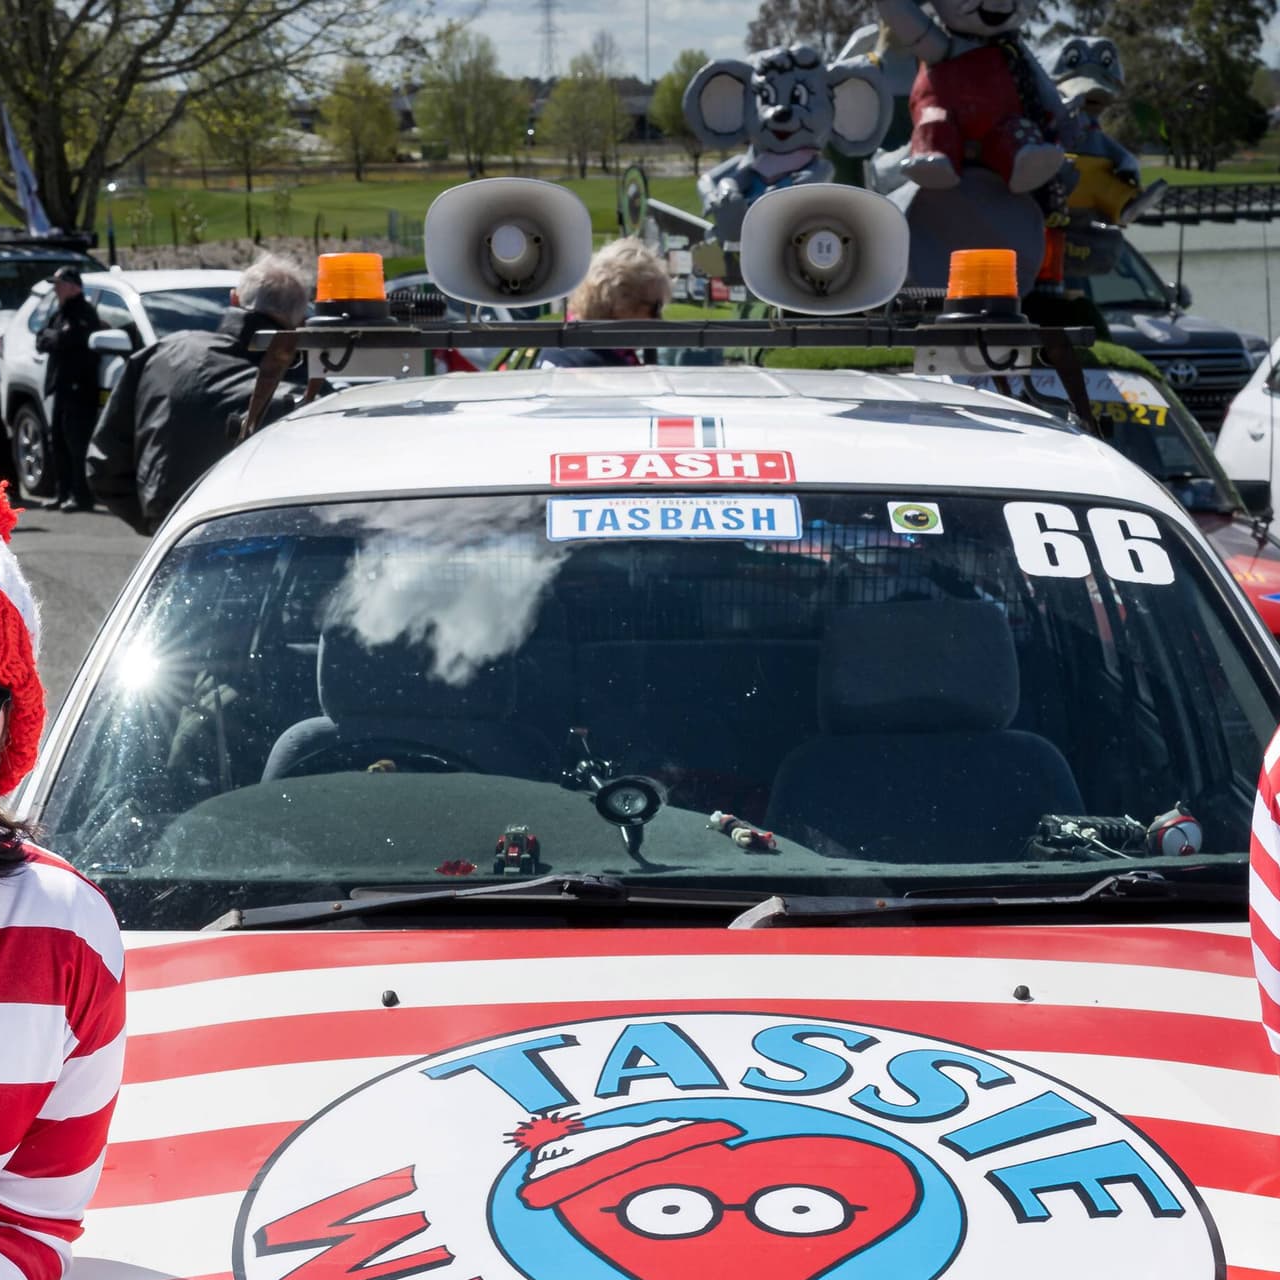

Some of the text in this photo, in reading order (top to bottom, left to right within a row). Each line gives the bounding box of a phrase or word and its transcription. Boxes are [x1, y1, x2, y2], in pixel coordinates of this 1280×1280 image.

[586, 453, 761, 480] BASH
[572, 507, 777, 532] TASBASH
[1003, 501, 1176, 585] 66
[422, 1020, 1186, 1223] TASSIE
